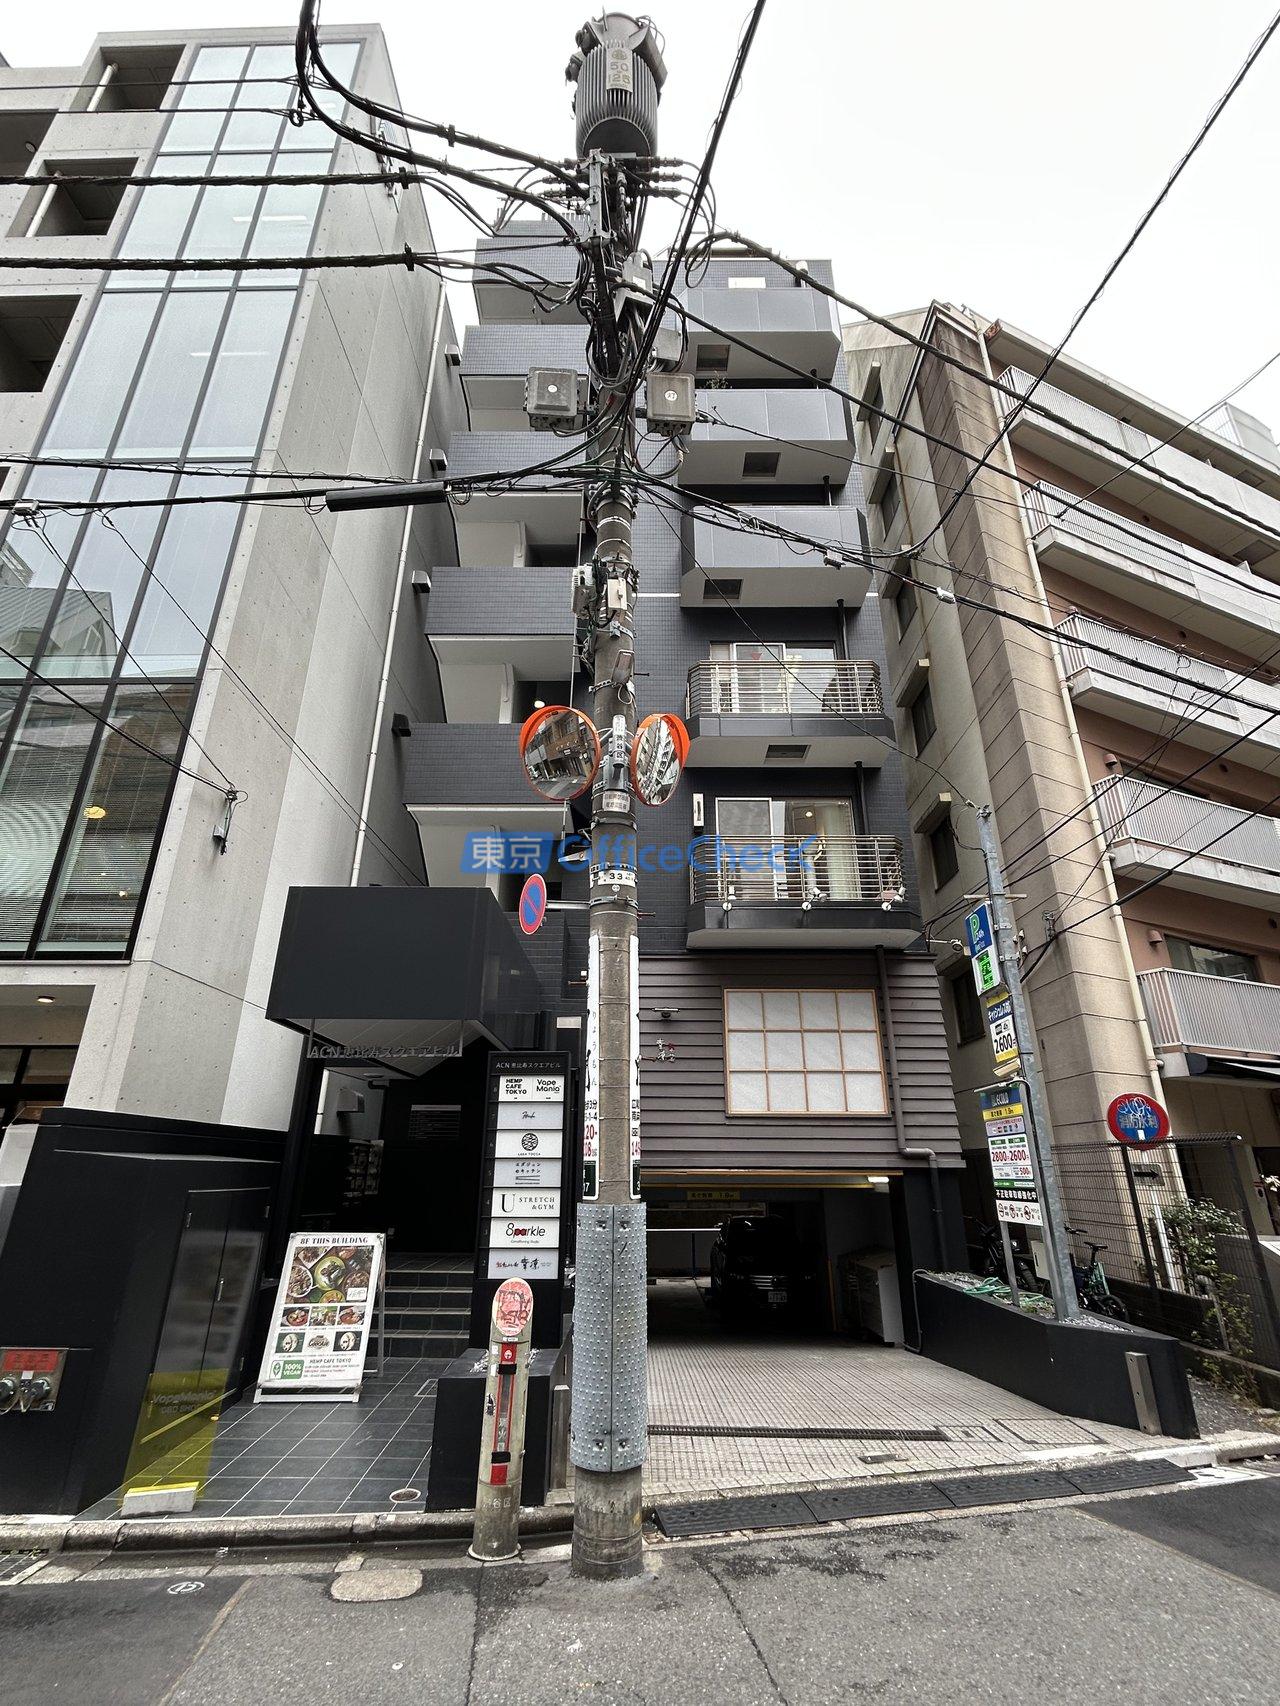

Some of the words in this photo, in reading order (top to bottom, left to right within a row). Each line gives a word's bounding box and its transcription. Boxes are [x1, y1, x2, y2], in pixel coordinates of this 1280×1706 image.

[537, 1079, 556, 1087] Vape
[501, 1194, 516, 1213] U
[312, 1237, 331, 1245] THIS
[332, 1236, 369, 1244] BUILDING
